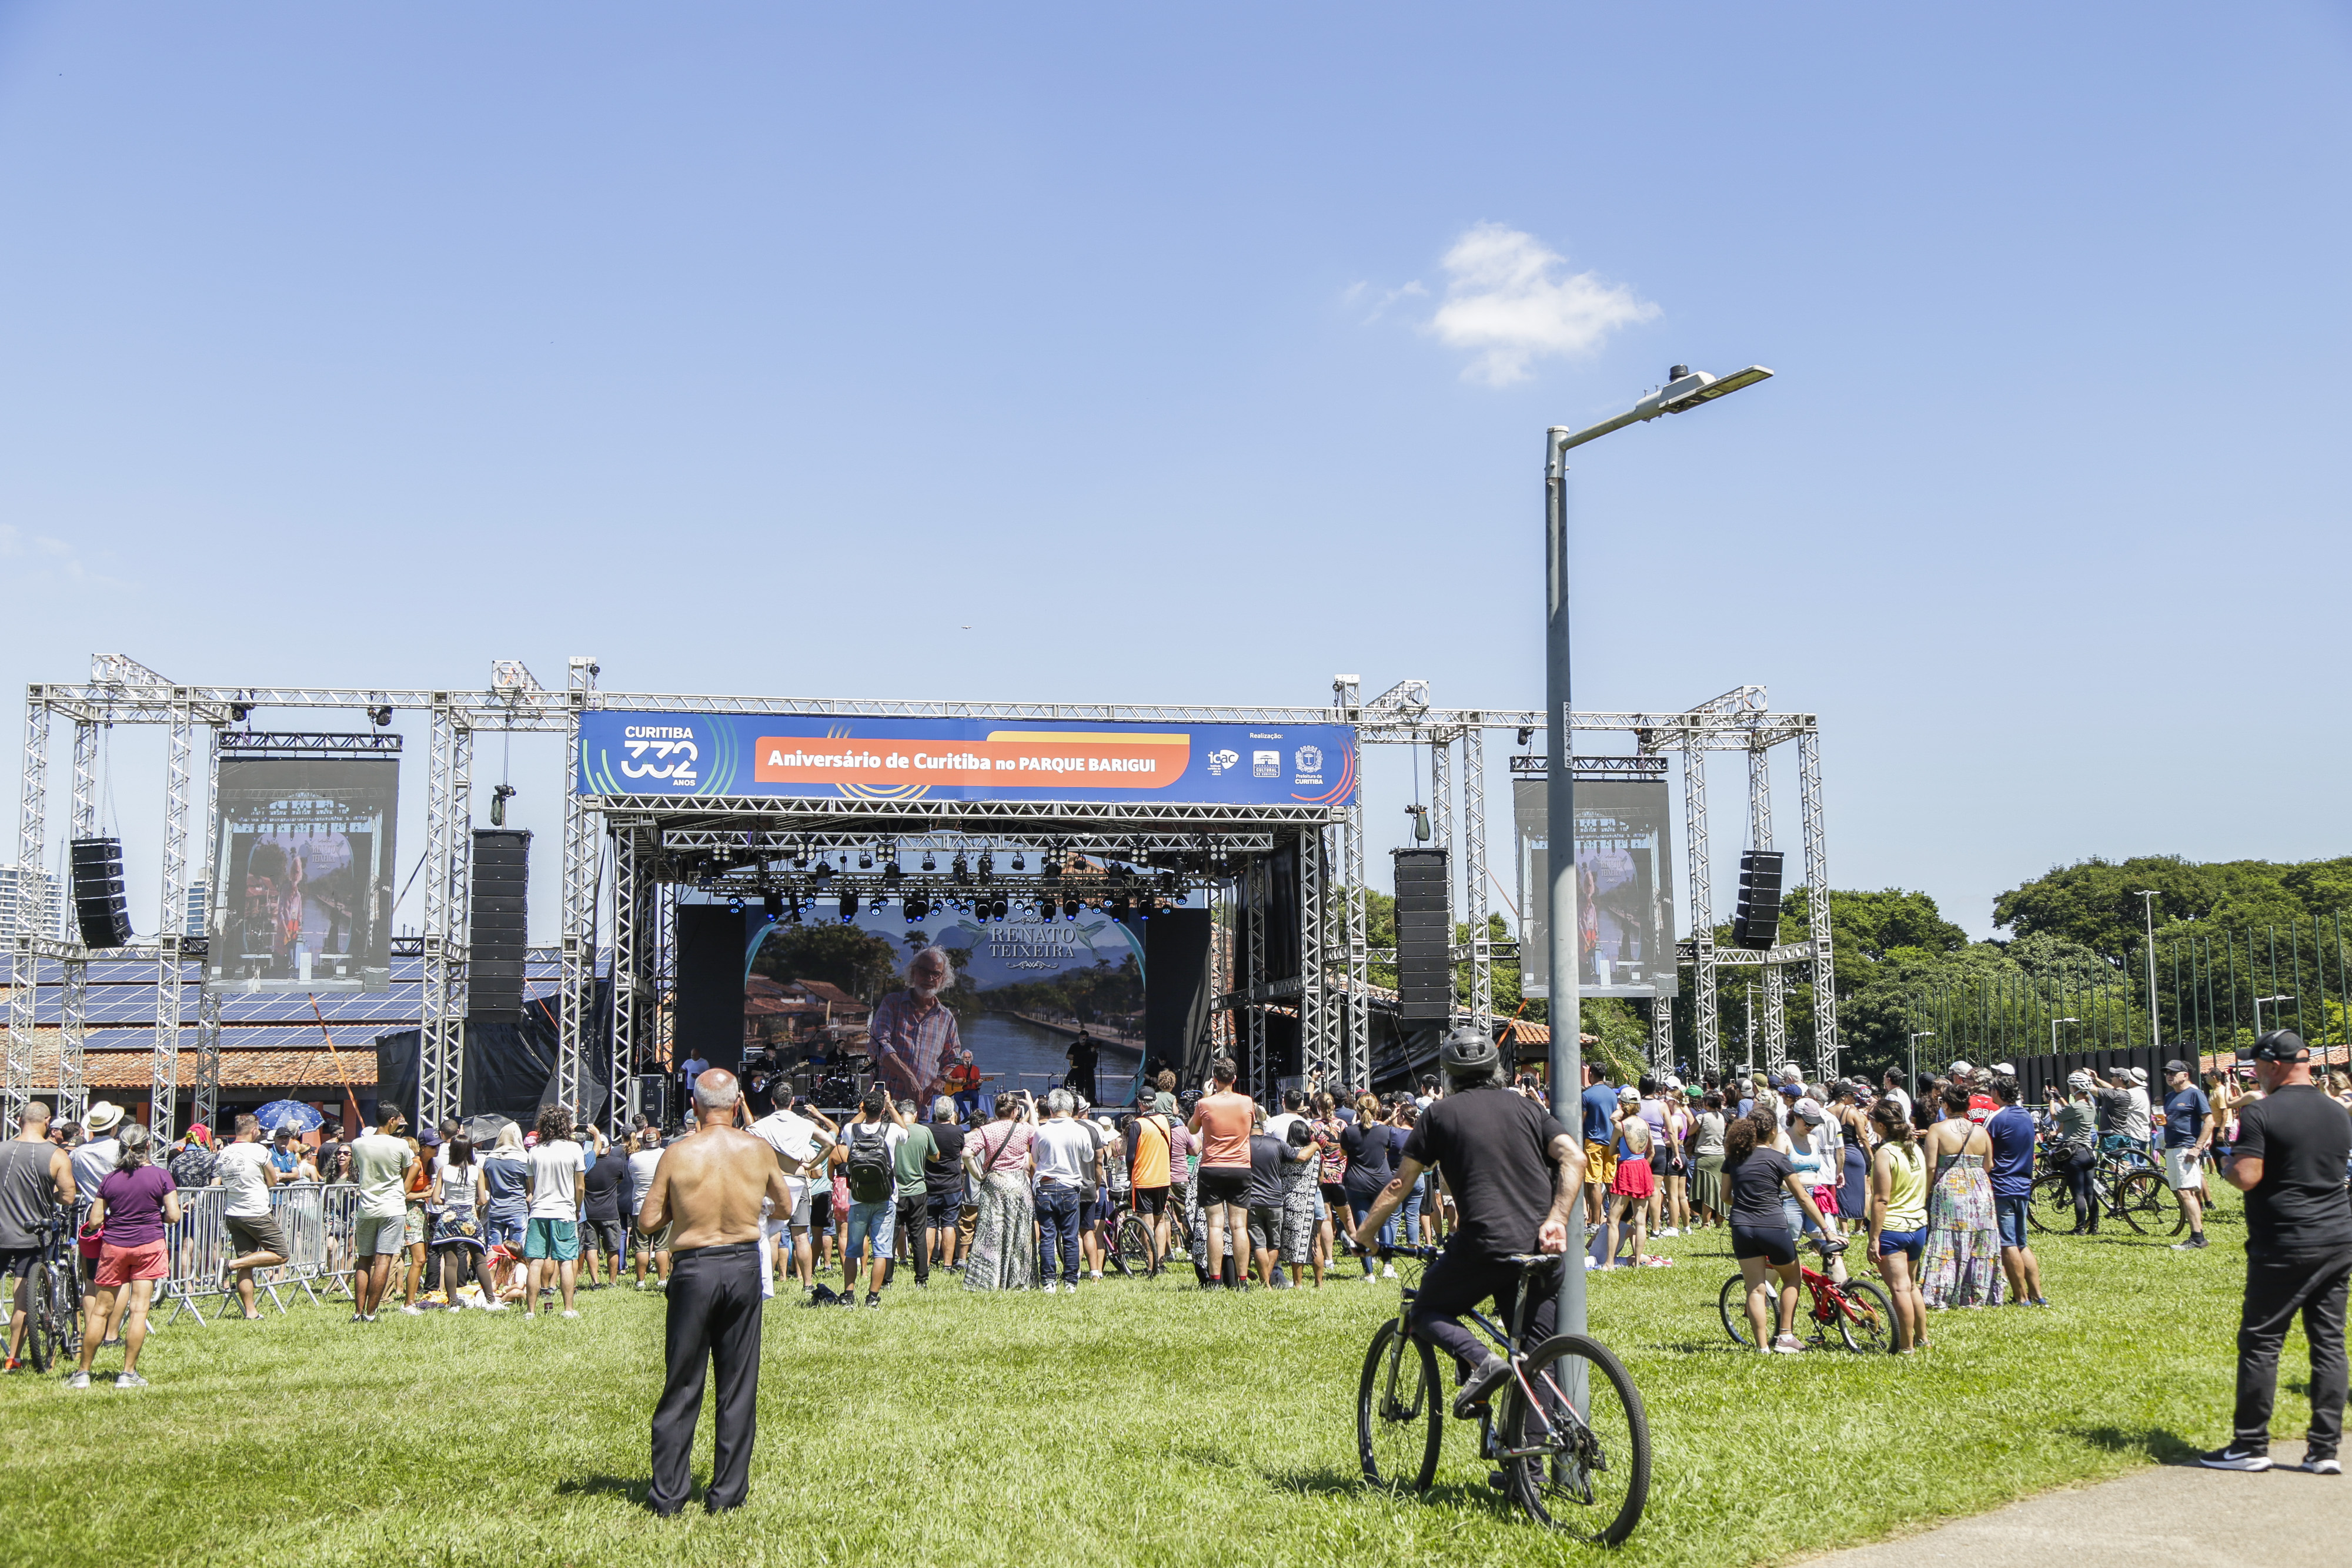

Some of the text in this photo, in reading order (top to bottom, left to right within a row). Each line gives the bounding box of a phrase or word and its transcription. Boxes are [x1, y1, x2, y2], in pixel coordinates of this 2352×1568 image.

[625, 726, 694, 739] CURITIBA
[621, 740, 698, 778] 332
[767, 750, 1155, 774] Aniversário de Curitiba no PARQUE BARIGUI
[1207, 751, 1235, 764] icac
[990, 927, 1075, 944] RENATO
[988, 945, 1075, 958] TEIXEIRA
